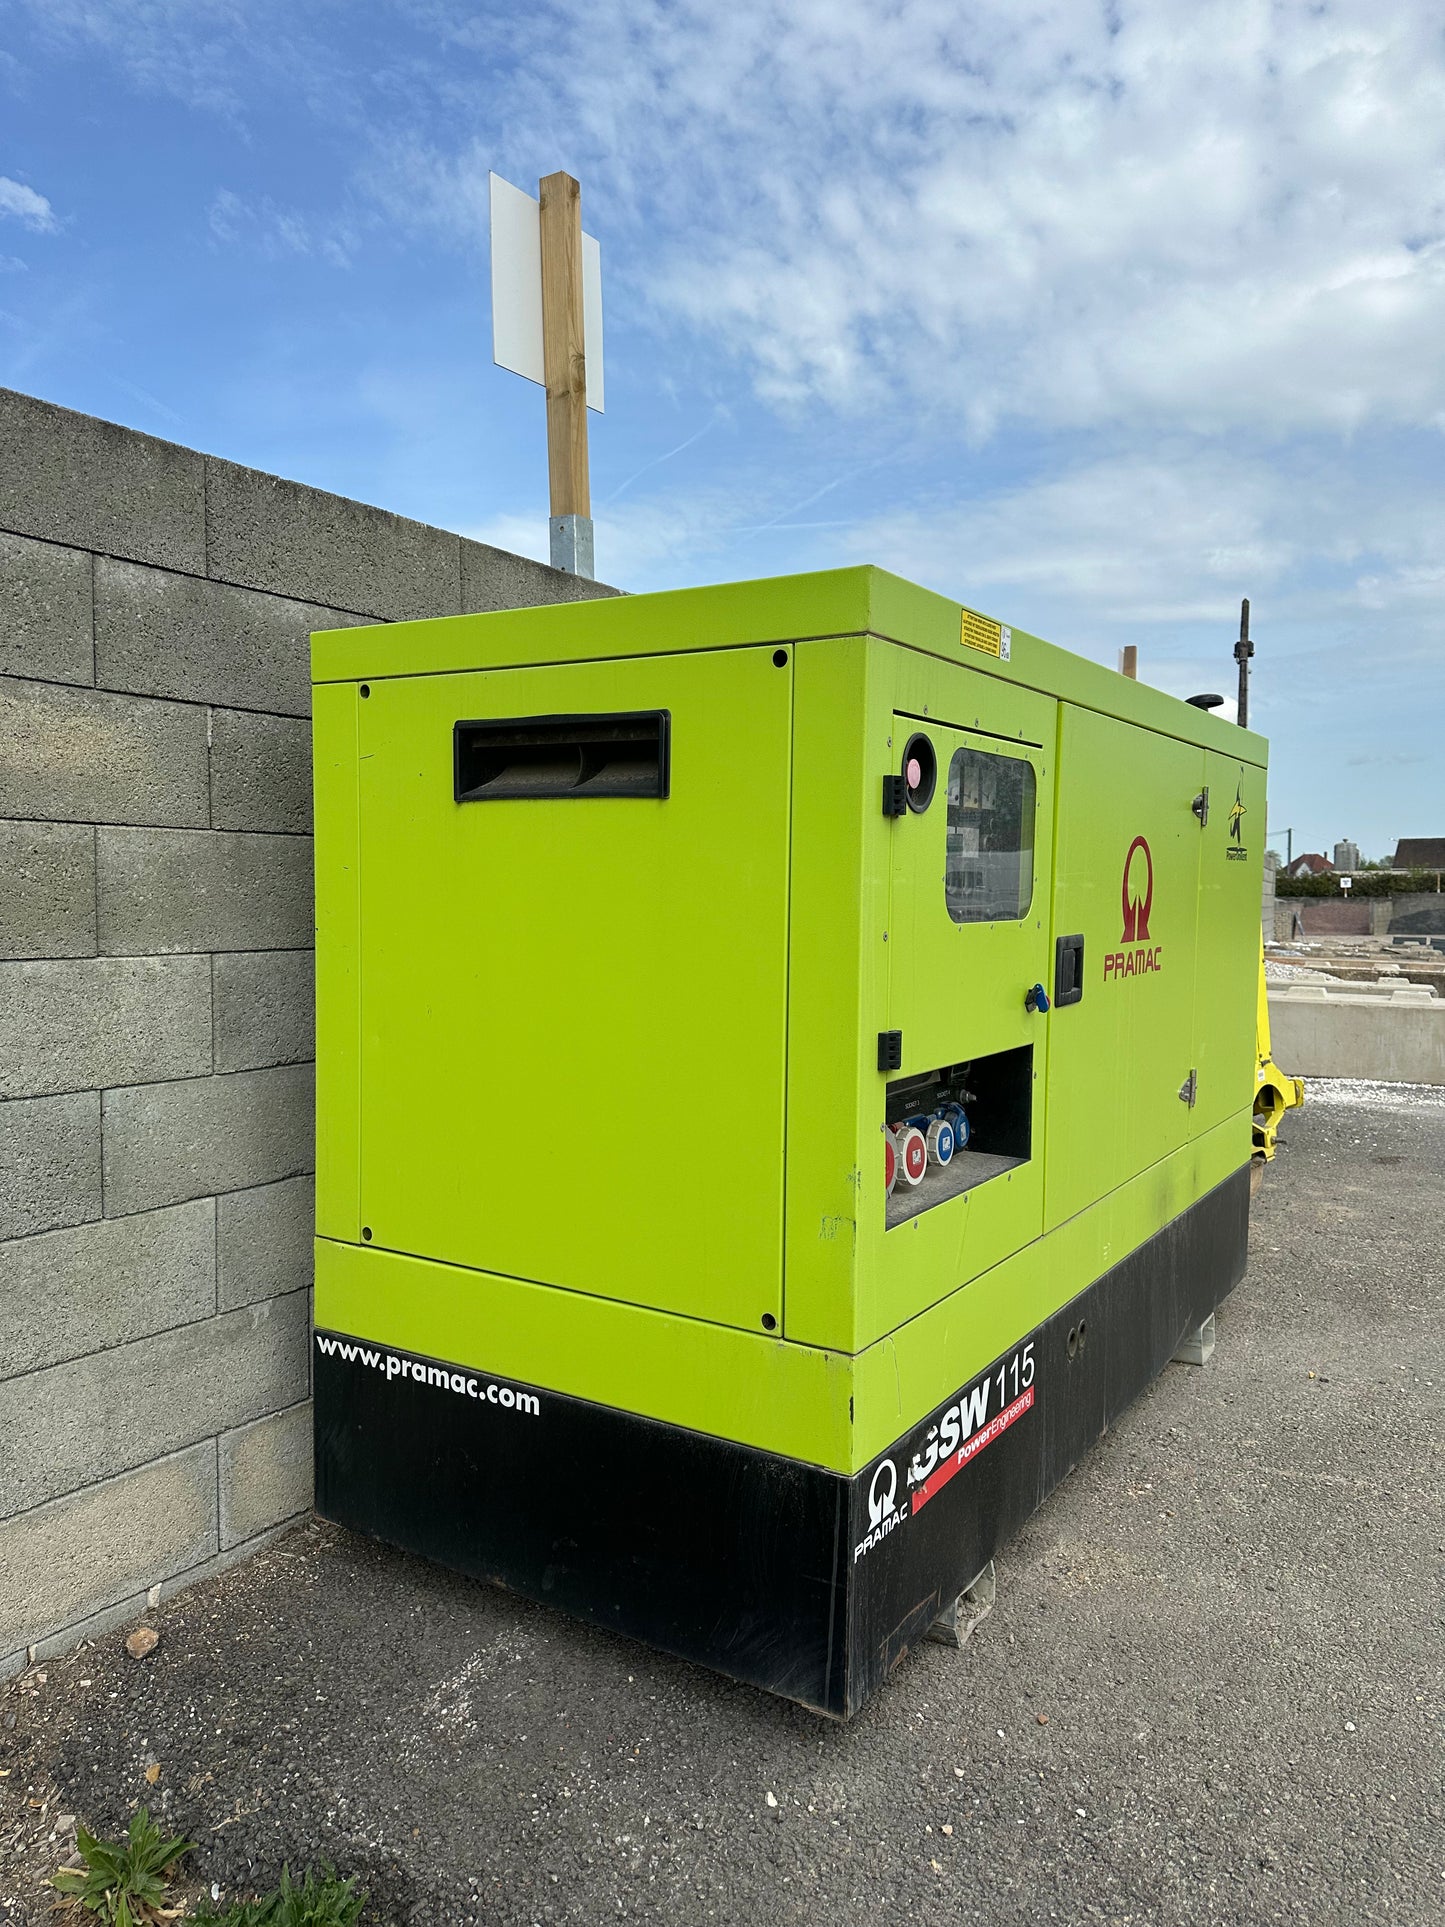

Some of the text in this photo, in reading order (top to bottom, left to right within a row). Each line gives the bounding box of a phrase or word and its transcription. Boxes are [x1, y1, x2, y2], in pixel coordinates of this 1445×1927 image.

[1103, 946, 1162, 982] PRAMAC
[316, 1335, 540, 1416] www.pramac.com
[996, 1341, 1035, 1408] 115
[854, 1501, 908, 1564] PRAMAC
